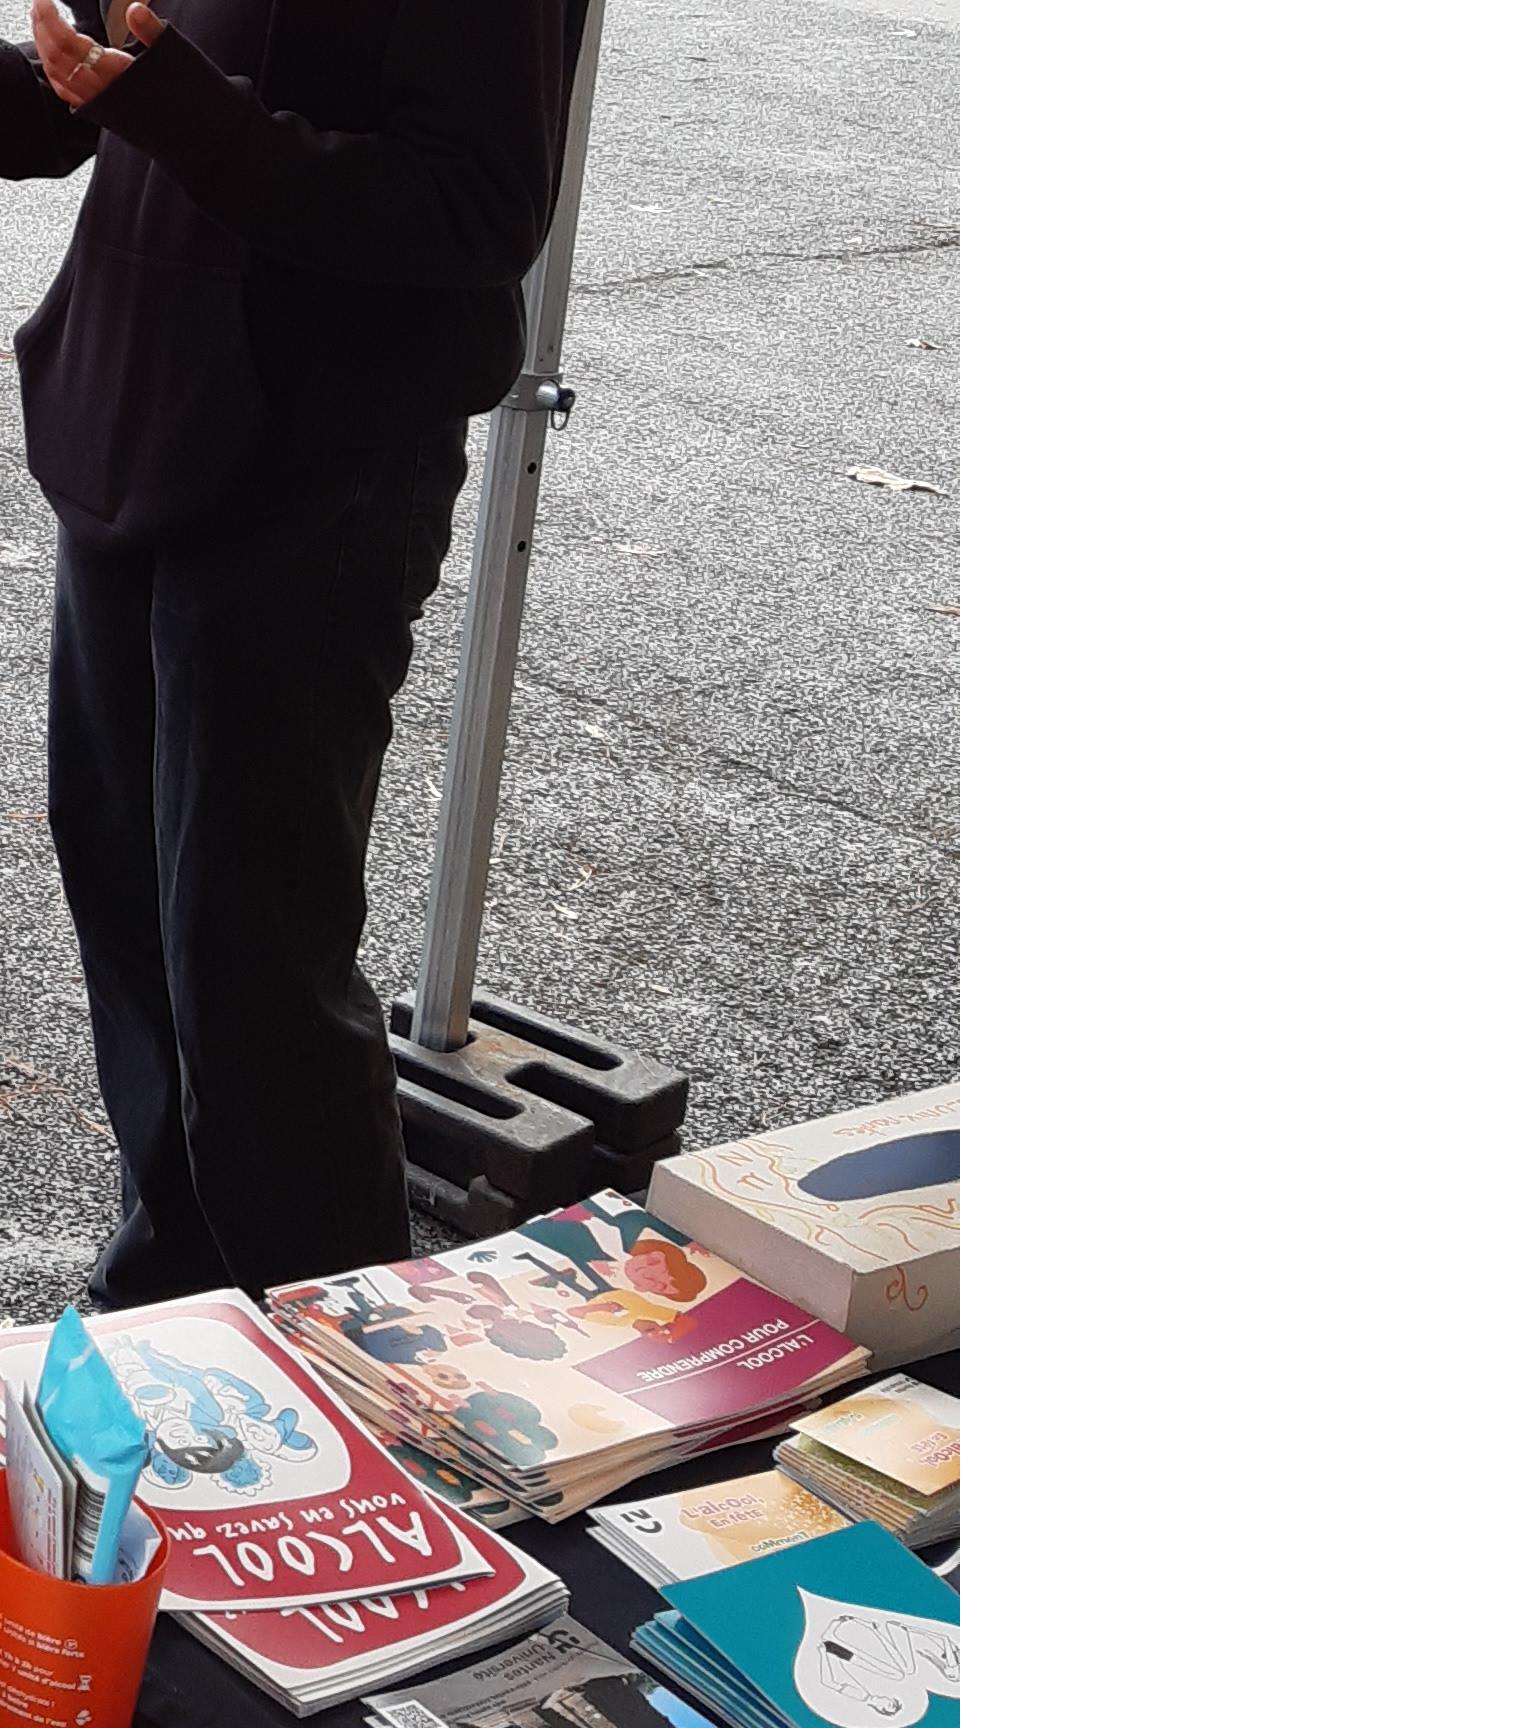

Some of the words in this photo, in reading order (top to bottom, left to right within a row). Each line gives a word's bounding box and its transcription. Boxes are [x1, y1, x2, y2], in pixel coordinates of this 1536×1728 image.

[741, 1318, 791, 1344] POUR
[636, 1339, 745, 1383] COMPRENDRE
[736, 1334, 815, 1370] L'ALCOOL
[300, 1506, 334, 1523] en
[340, 1493, 406, 1519] vous
[216, 1512, 293, 1539] savez
[192, 1511, 433, 1587] ALCOOL
[503, 1652, 557, 1681] Nantes
